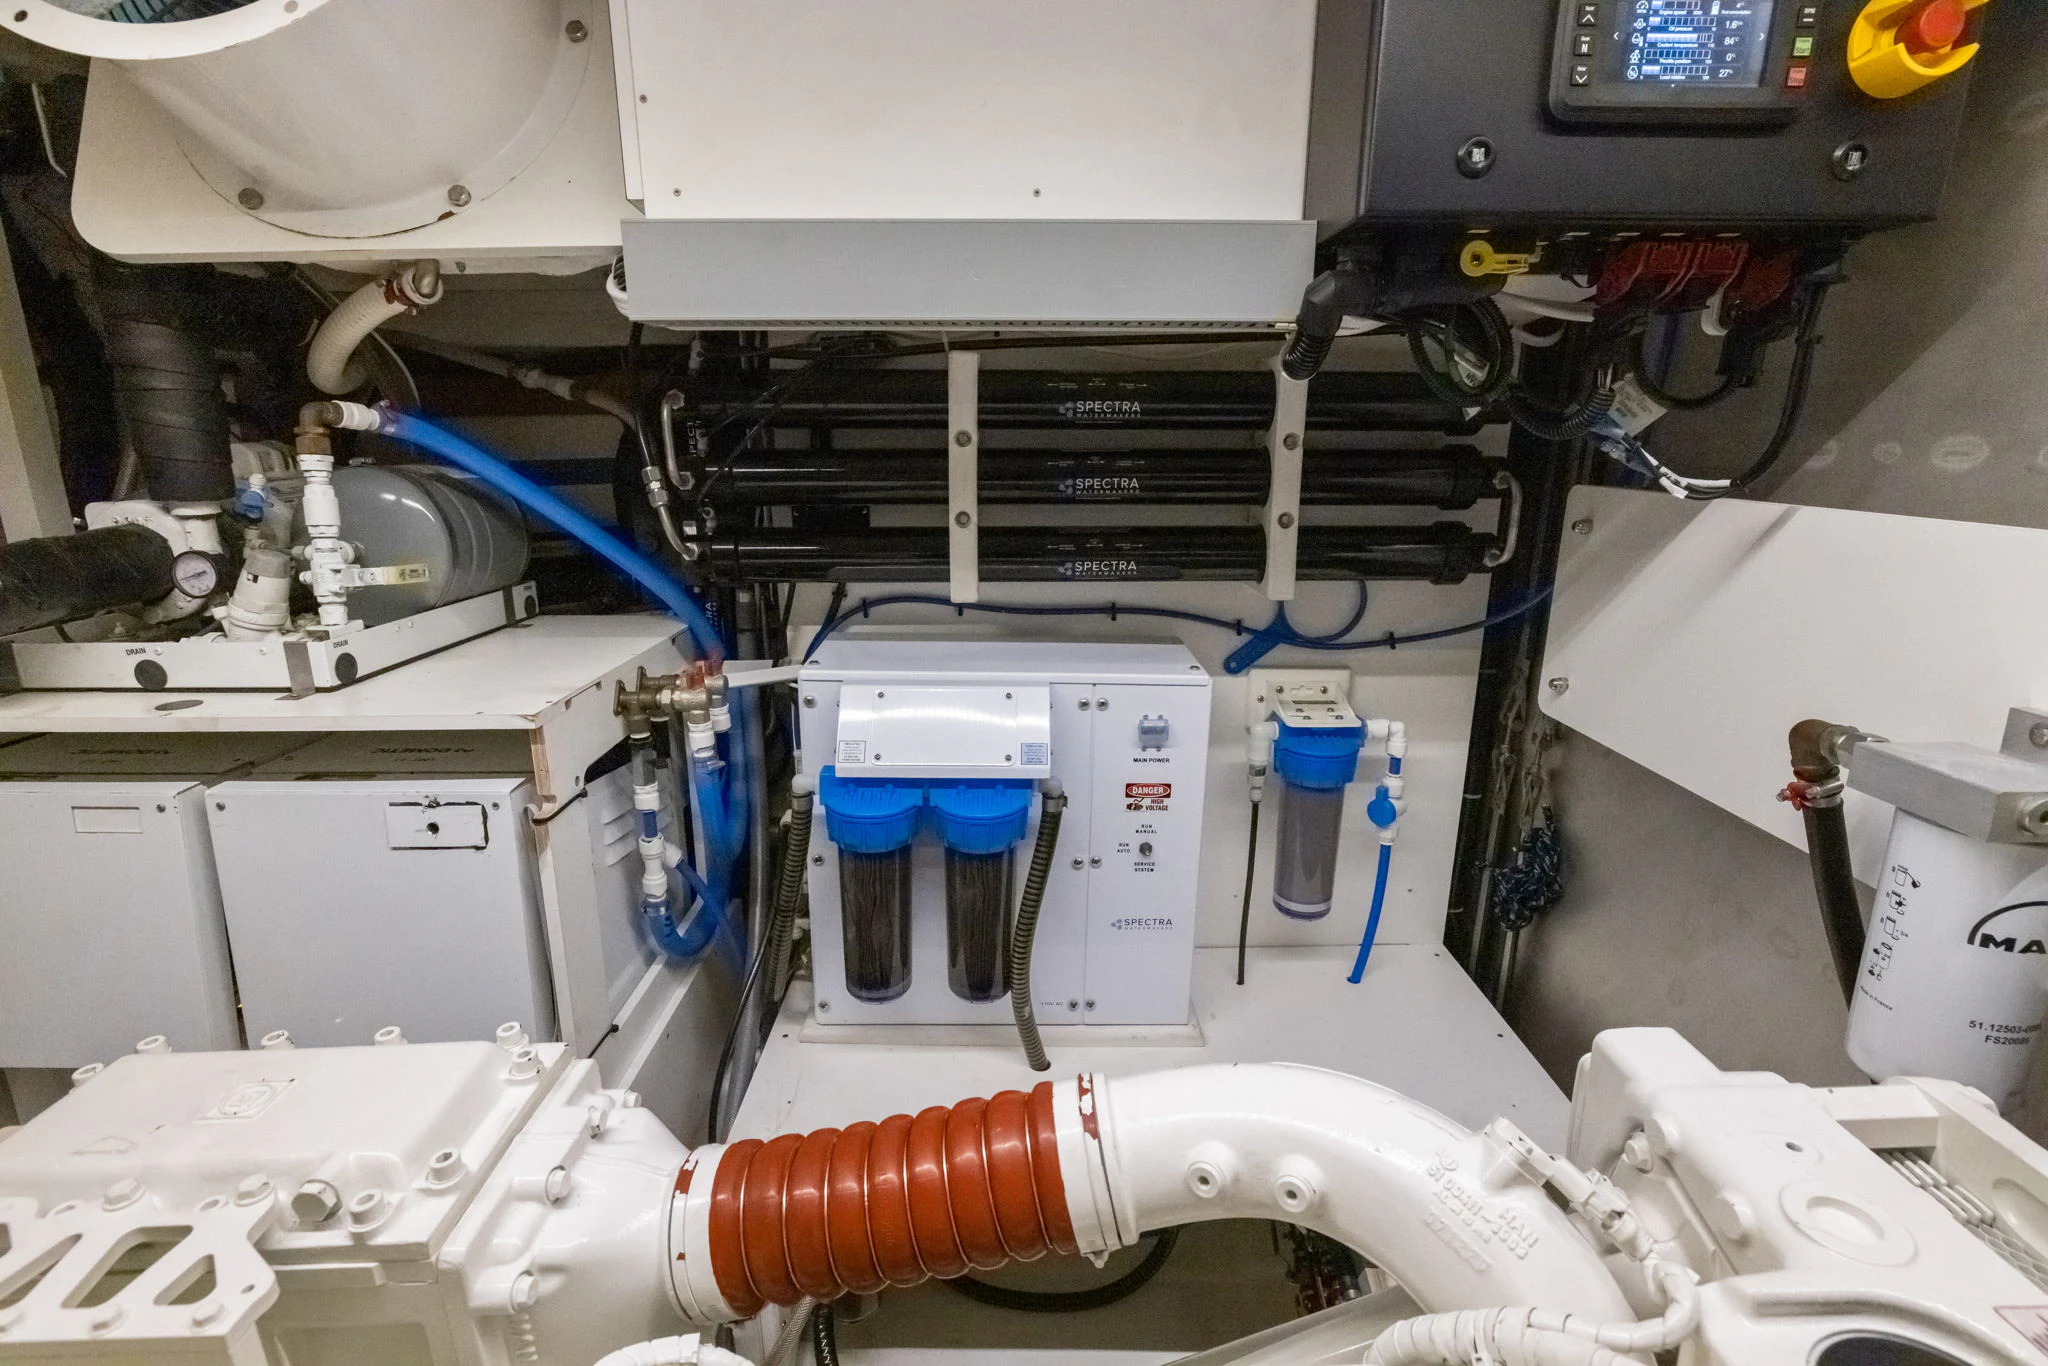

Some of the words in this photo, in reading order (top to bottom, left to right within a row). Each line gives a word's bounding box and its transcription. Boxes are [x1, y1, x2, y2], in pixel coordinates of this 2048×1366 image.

[1726, 21, 1737, 29] 1.6
[1724, 37, 1734, 45] 84
[1582, 44, 1588, 53] N
[1726, 53, 1732, 61] 0
[1076, 401, 1140, 412] SPECTRA
[1076, 478, 1139, 489] SPECTRA
[1075, 561, 1137, 571] SPECTRA
[332, 640, 348, 648] DRAIN
[126, 648, 146, 656] DRAIN
[1979, 932, 2046, 954] MA
[1874, 997, 1893, 1011] France
